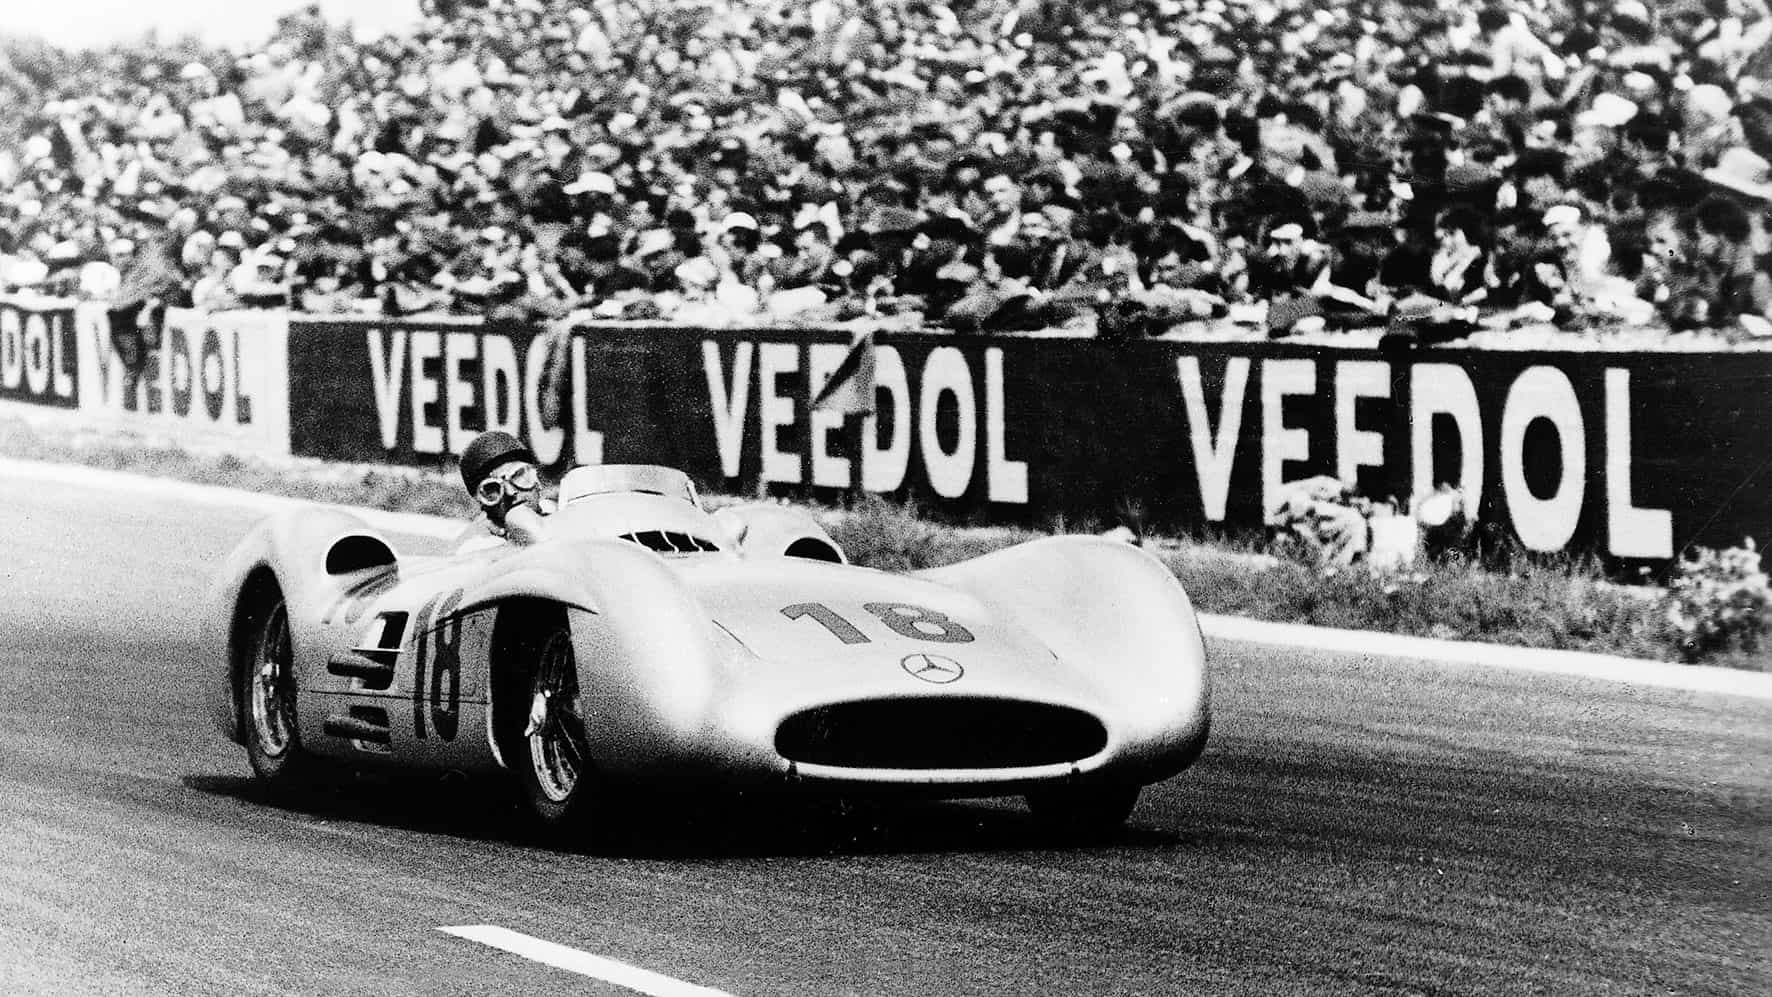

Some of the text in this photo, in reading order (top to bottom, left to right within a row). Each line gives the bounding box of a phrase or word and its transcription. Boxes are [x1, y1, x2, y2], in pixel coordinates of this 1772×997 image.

[702, 339, 1028, 503] VEEDOL
[1177, 356, 1673, 558] VEEDOL
[413, 588, 465, 740] 18
[779, 601, 975, 645] 18
